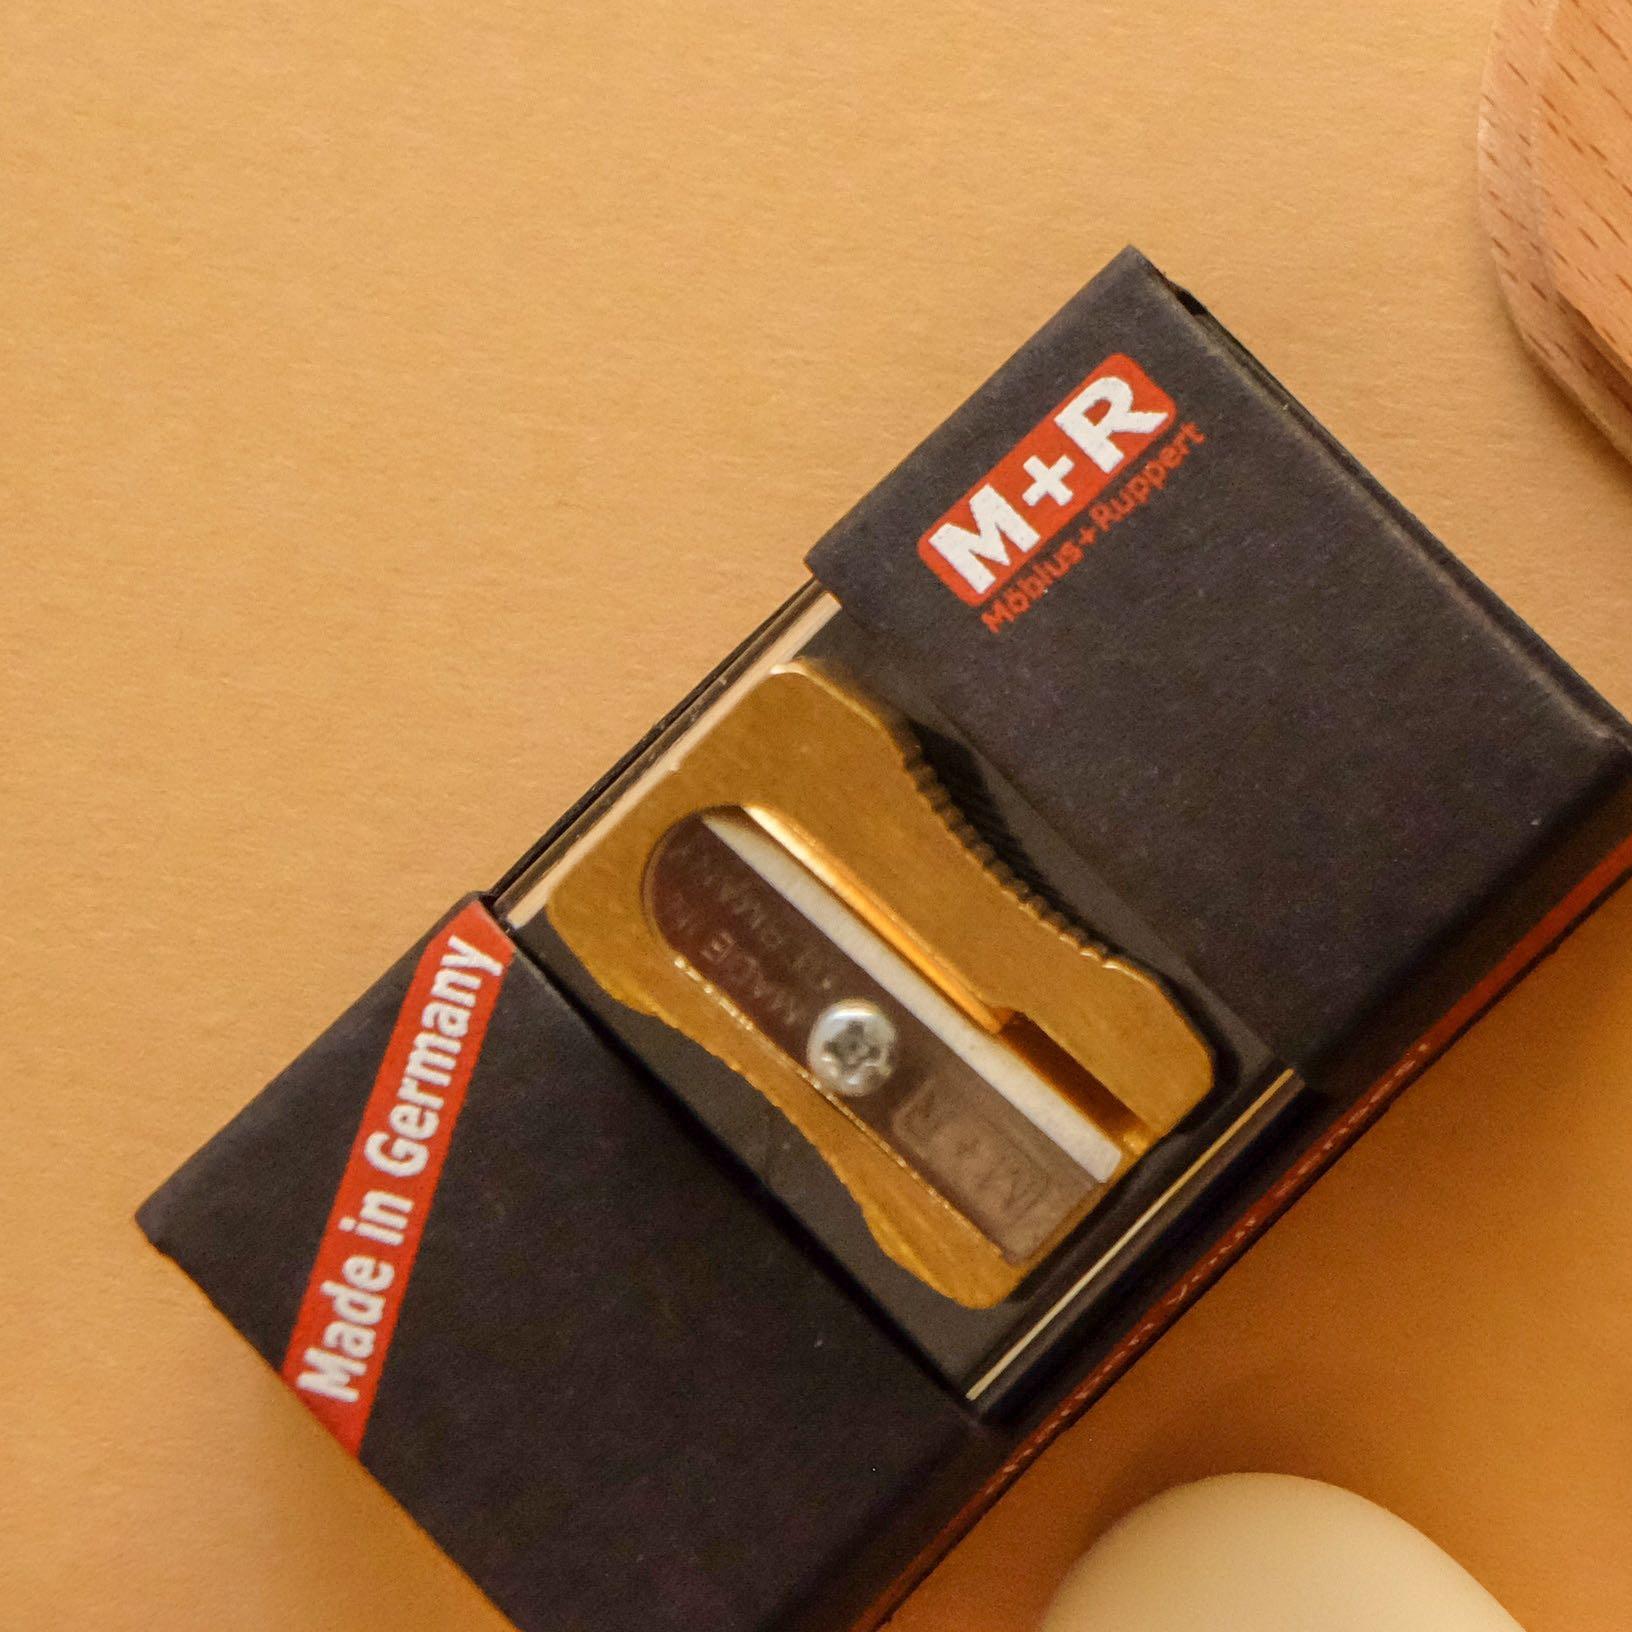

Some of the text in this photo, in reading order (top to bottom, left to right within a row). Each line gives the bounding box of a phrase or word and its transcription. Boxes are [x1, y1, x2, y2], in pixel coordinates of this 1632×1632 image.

[928, 375, 1169, 595] M+R
[296, 935, 504, 1403] Made in Germany
